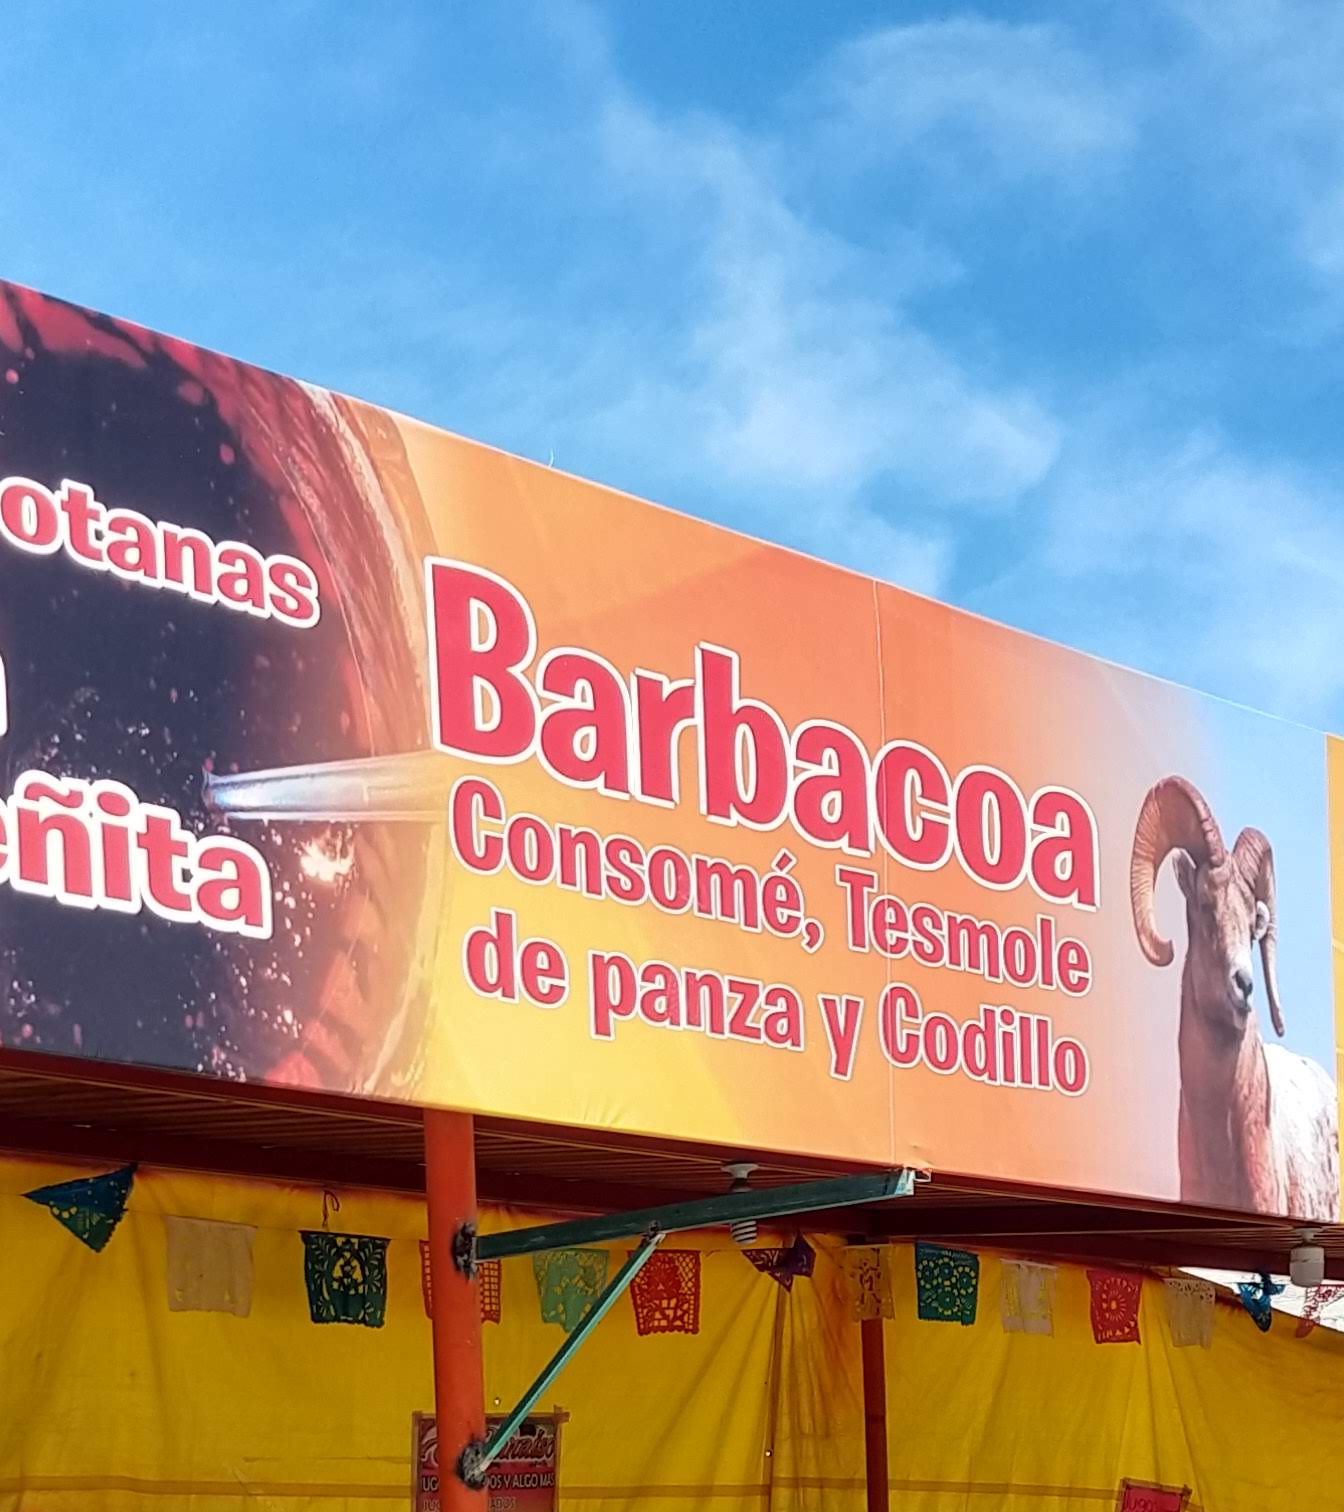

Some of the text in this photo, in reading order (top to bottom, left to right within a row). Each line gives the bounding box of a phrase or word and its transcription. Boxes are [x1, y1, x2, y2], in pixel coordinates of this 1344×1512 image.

[425, 556, 1098, 910] Barbacoa
[450, 776, 1092, 998] Consomé, Tesmole
[464, 912, 1089, 1098] de panza y Codillo
